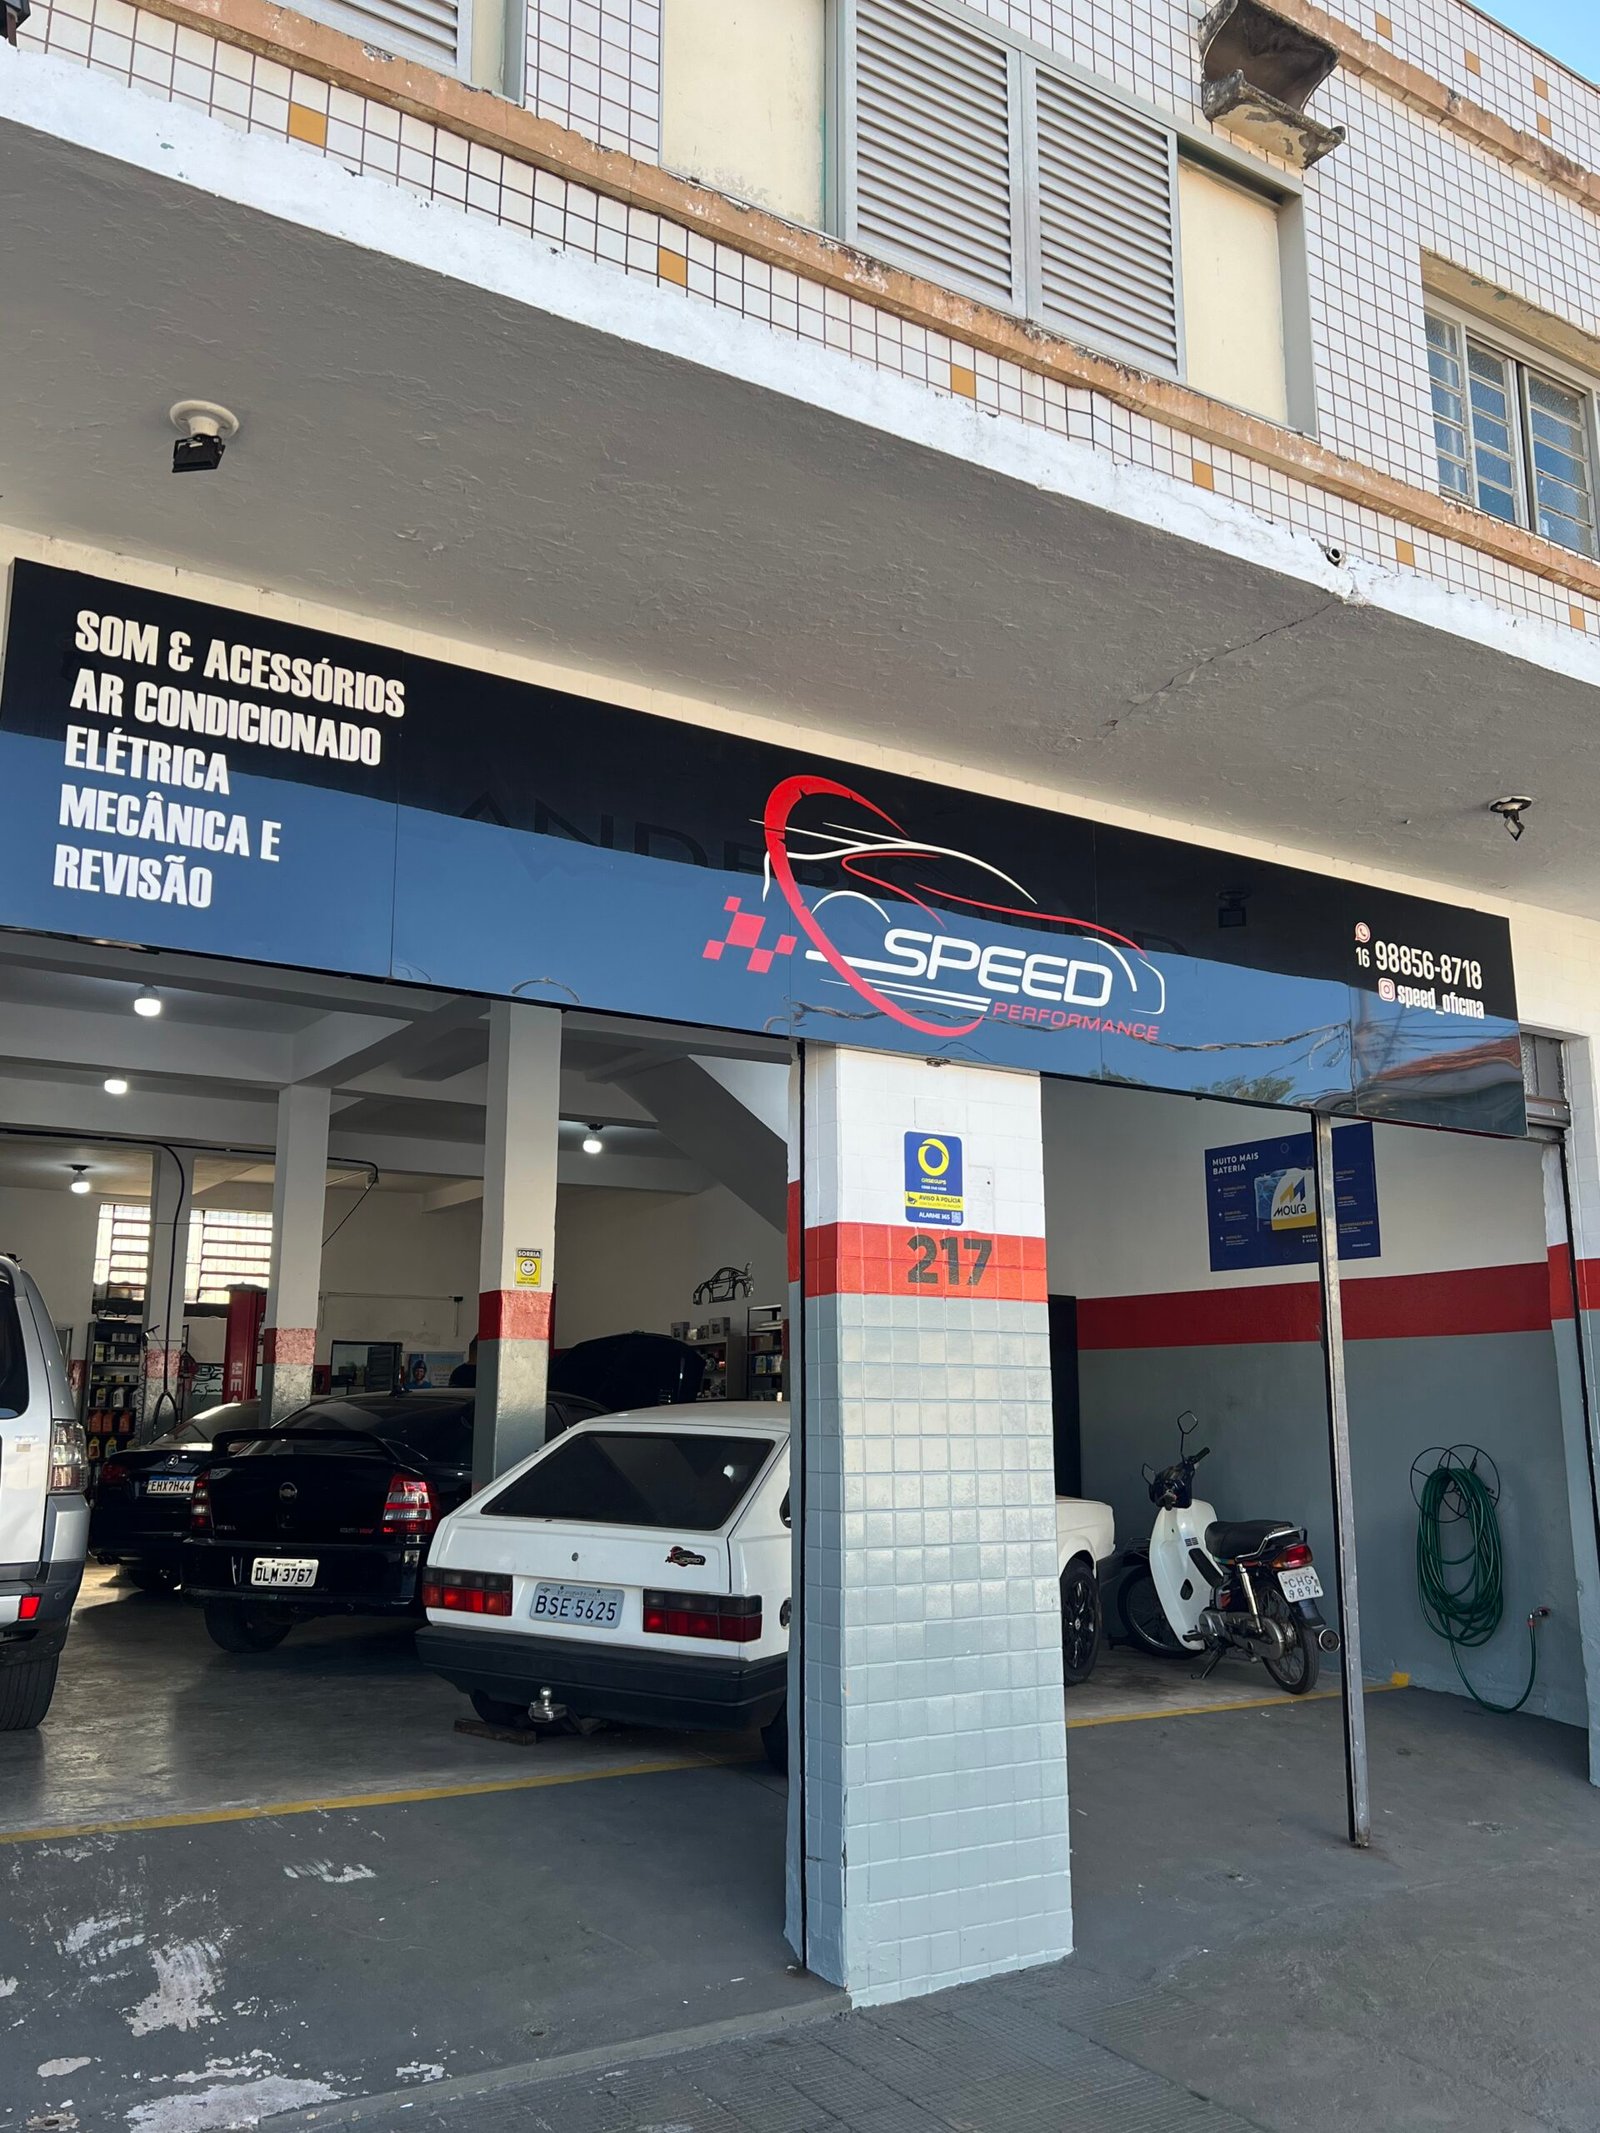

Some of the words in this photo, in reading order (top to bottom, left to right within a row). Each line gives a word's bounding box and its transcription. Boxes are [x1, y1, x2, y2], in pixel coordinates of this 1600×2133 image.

[75, 609, 159, 666] SOM
[168, 631, 194, 672] &
[203, 638, 405, 718] ACESSÓRIOS
[69, 667, 124, 718] AR
[134, 681, 381, 767] CONDICIONADO
[64, 724, 230, 796] ELÉTRICA
[59, 783, 250, 858] MECÂNICA
[260, 820, 282, 862] E
[52, 844, 213, 909] REVISÃO
[884, 928, 1112, 1008] SPEED
[1355, 946, 1371, 968] 16
[1374, 940, 1483, 990] 98856-8718
[993, 1002, 1160, 1041] PERFORMANCE
[1212, 1154, 1238, 1166] MUITO
[1239, 1151, 1259, 1162] MAIS
[1212, 1163, 1246, 1176] BATERIA
[907, 1234, 993, 1286] 217
[150, 1480, 191, 1492] EHX7H44
[1288, 1575, 1312, 1588] CHG
